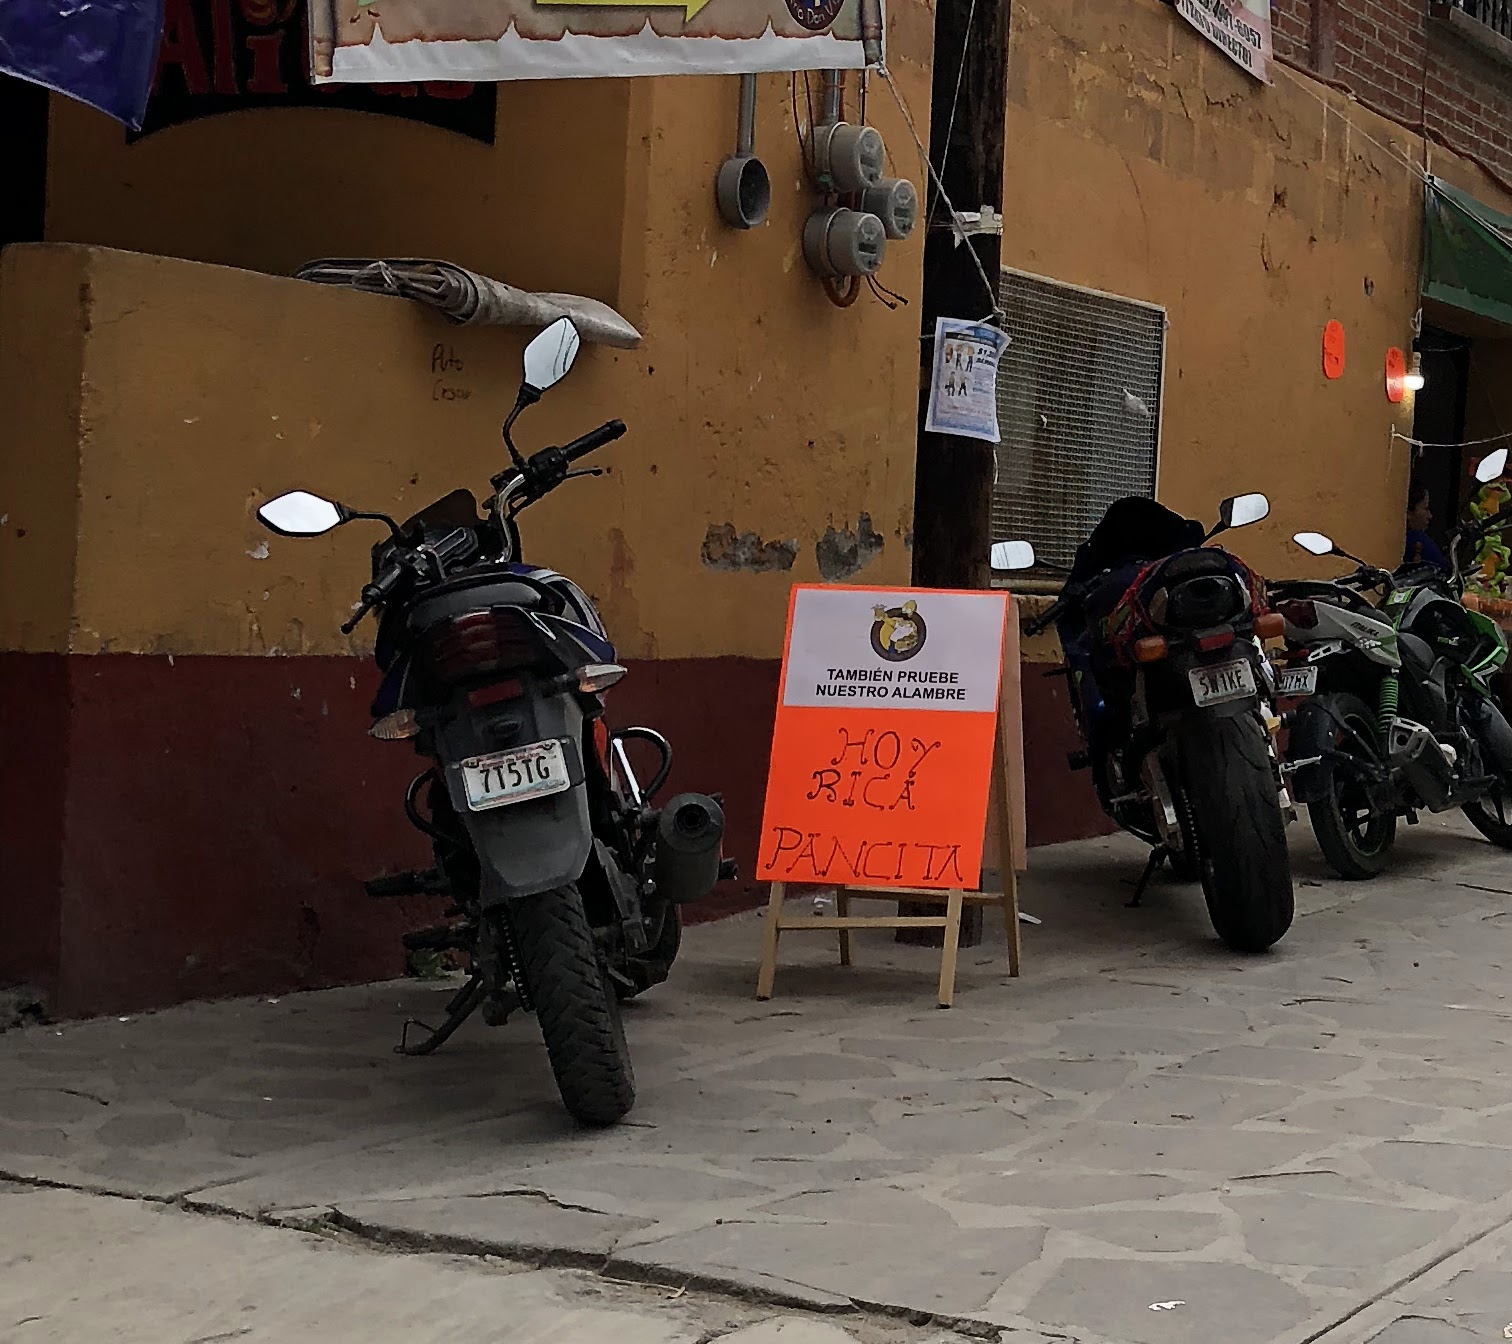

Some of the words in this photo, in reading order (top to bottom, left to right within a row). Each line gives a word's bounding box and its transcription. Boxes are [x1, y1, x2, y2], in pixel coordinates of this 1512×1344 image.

[815, 684, 889, 698] NUESTRO
[891, 686, 966, 700] ALAMBRE
[826, 666, 893, 683] TAMBIÉN
[897, 670, 959, 684] PRUEBE
[831, 727, 941, 778] HOY
[479, 755, 551, 794] 7T5TG
[806, 768, 916, 811] RICA
[764, 826, 964, 882] PANCITA
